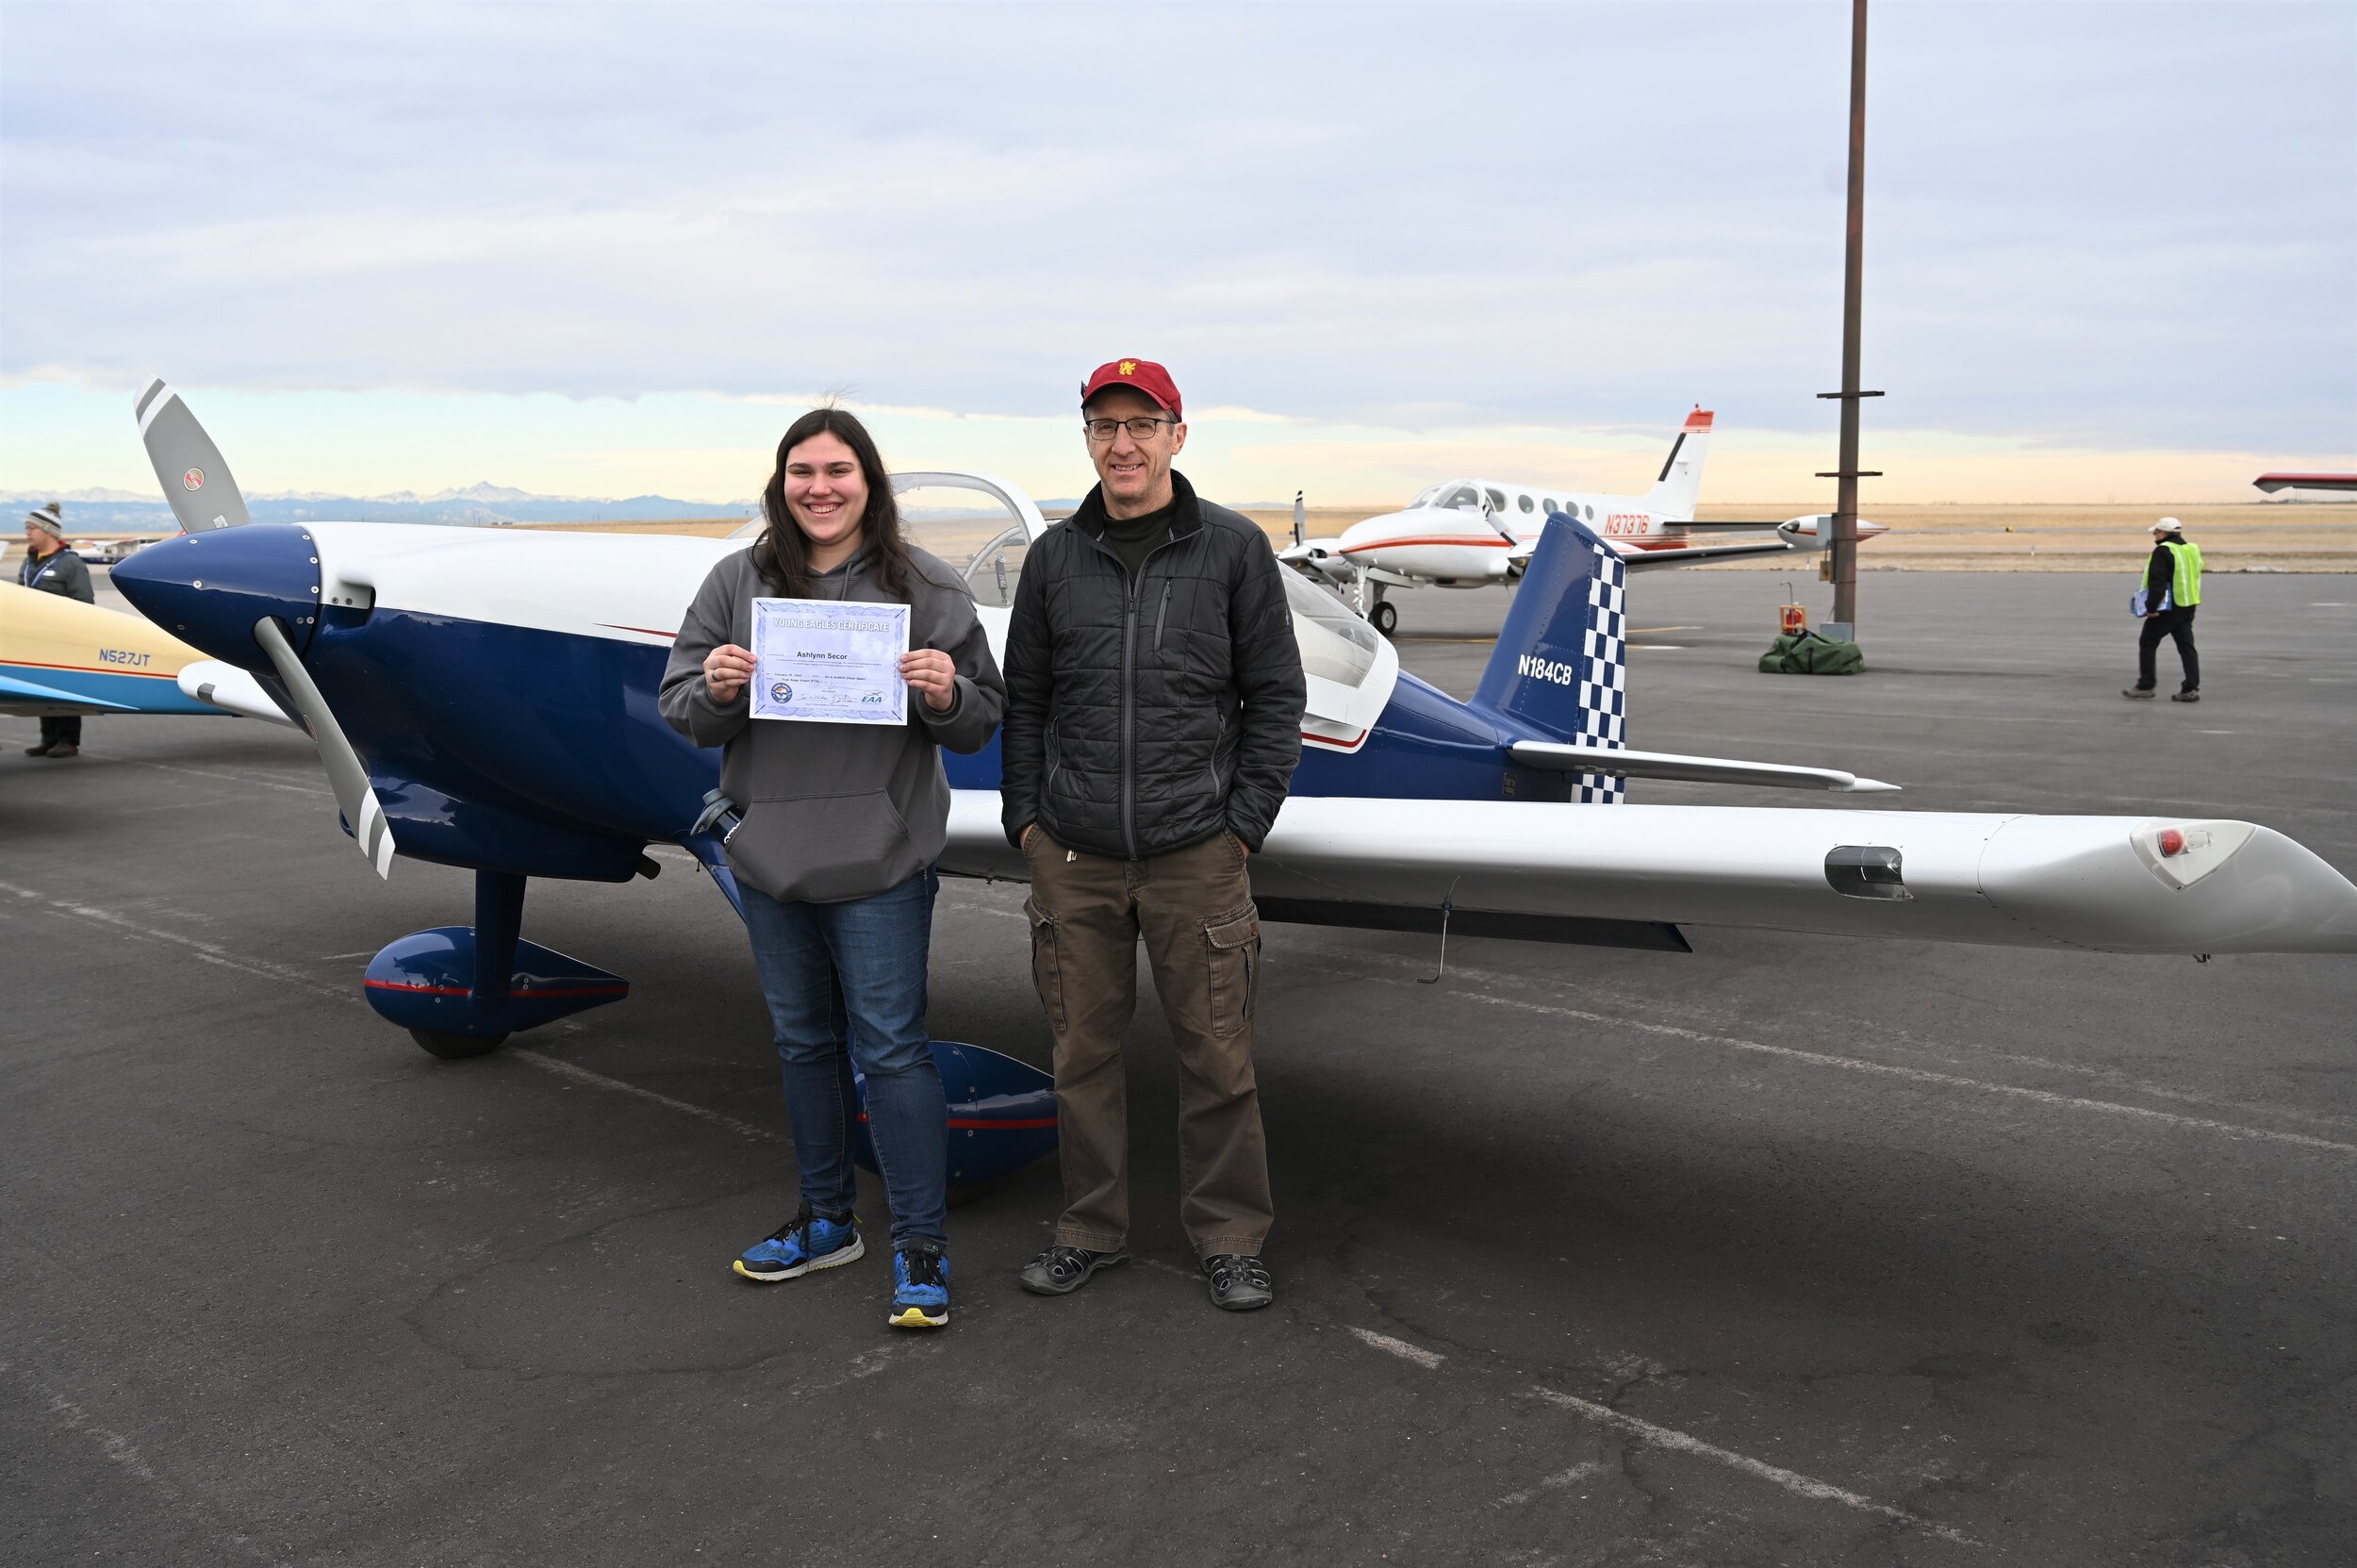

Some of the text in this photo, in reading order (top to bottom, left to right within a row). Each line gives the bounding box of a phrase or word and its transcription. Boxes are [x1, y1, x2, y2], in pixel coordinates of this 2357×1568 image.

[1605, 514, 1650, 535] N37376
[773, 618, 889, 633] YOUNG EAGLES CERTIFICATE
[99, 649, 151, 667] N527JT
[797, 651, 826, 660] Ashlynn
[1517, 653, 1573, 685] N184CB
